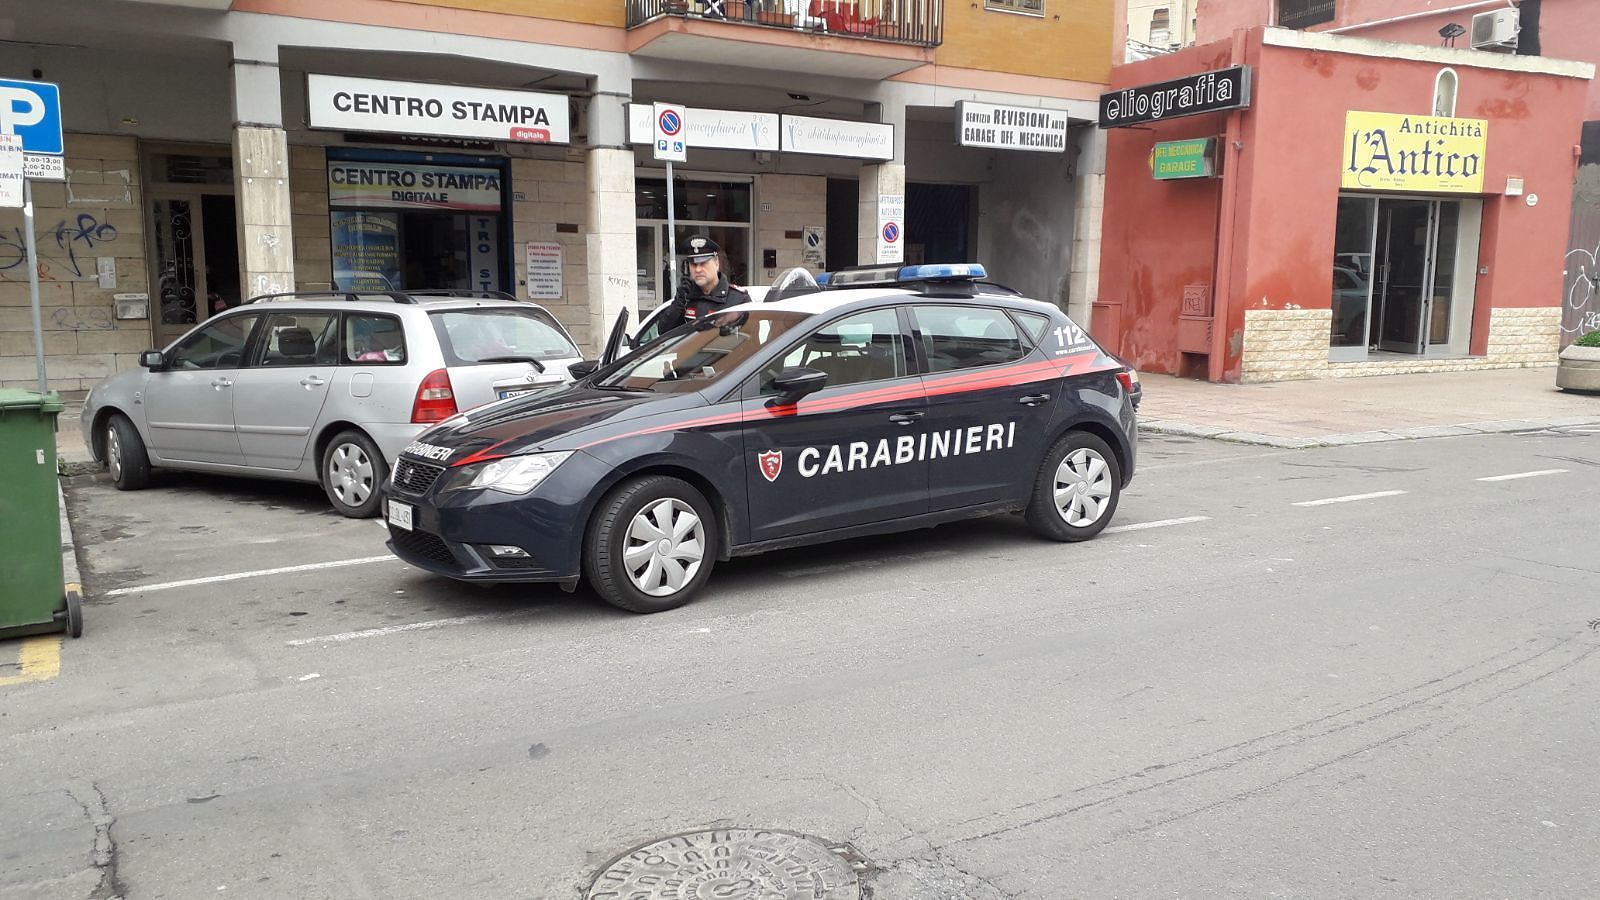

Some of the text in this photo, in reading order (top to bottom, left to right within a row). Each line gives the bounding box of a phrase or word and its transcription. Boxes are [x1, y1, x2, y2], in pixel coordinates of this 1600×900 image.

[1106, 73, 1233, 120] eliografia
[333, 91, 550, 126] CENTRO STAMPA
[966, 109, 1065, 130] SERVIZIO REVISIONI AUTO
[516, 130, 545, 139] digitale
[965, 127, 1064, 149] GARAGE OFF. MECCANICA
[1399, 118, 1482, 138] Antichità
[1159, 160, 1197, 173] GARAGE
[1347, 129, 1481, 187] l'Antico
[331, 168, 500, 192] CENTRO STAMPA
[392, 191, 449, 203] DIGITALE
[1053, 324, 1086, 347] 112
[797, 421, 1016, 479] CARABINIERI
